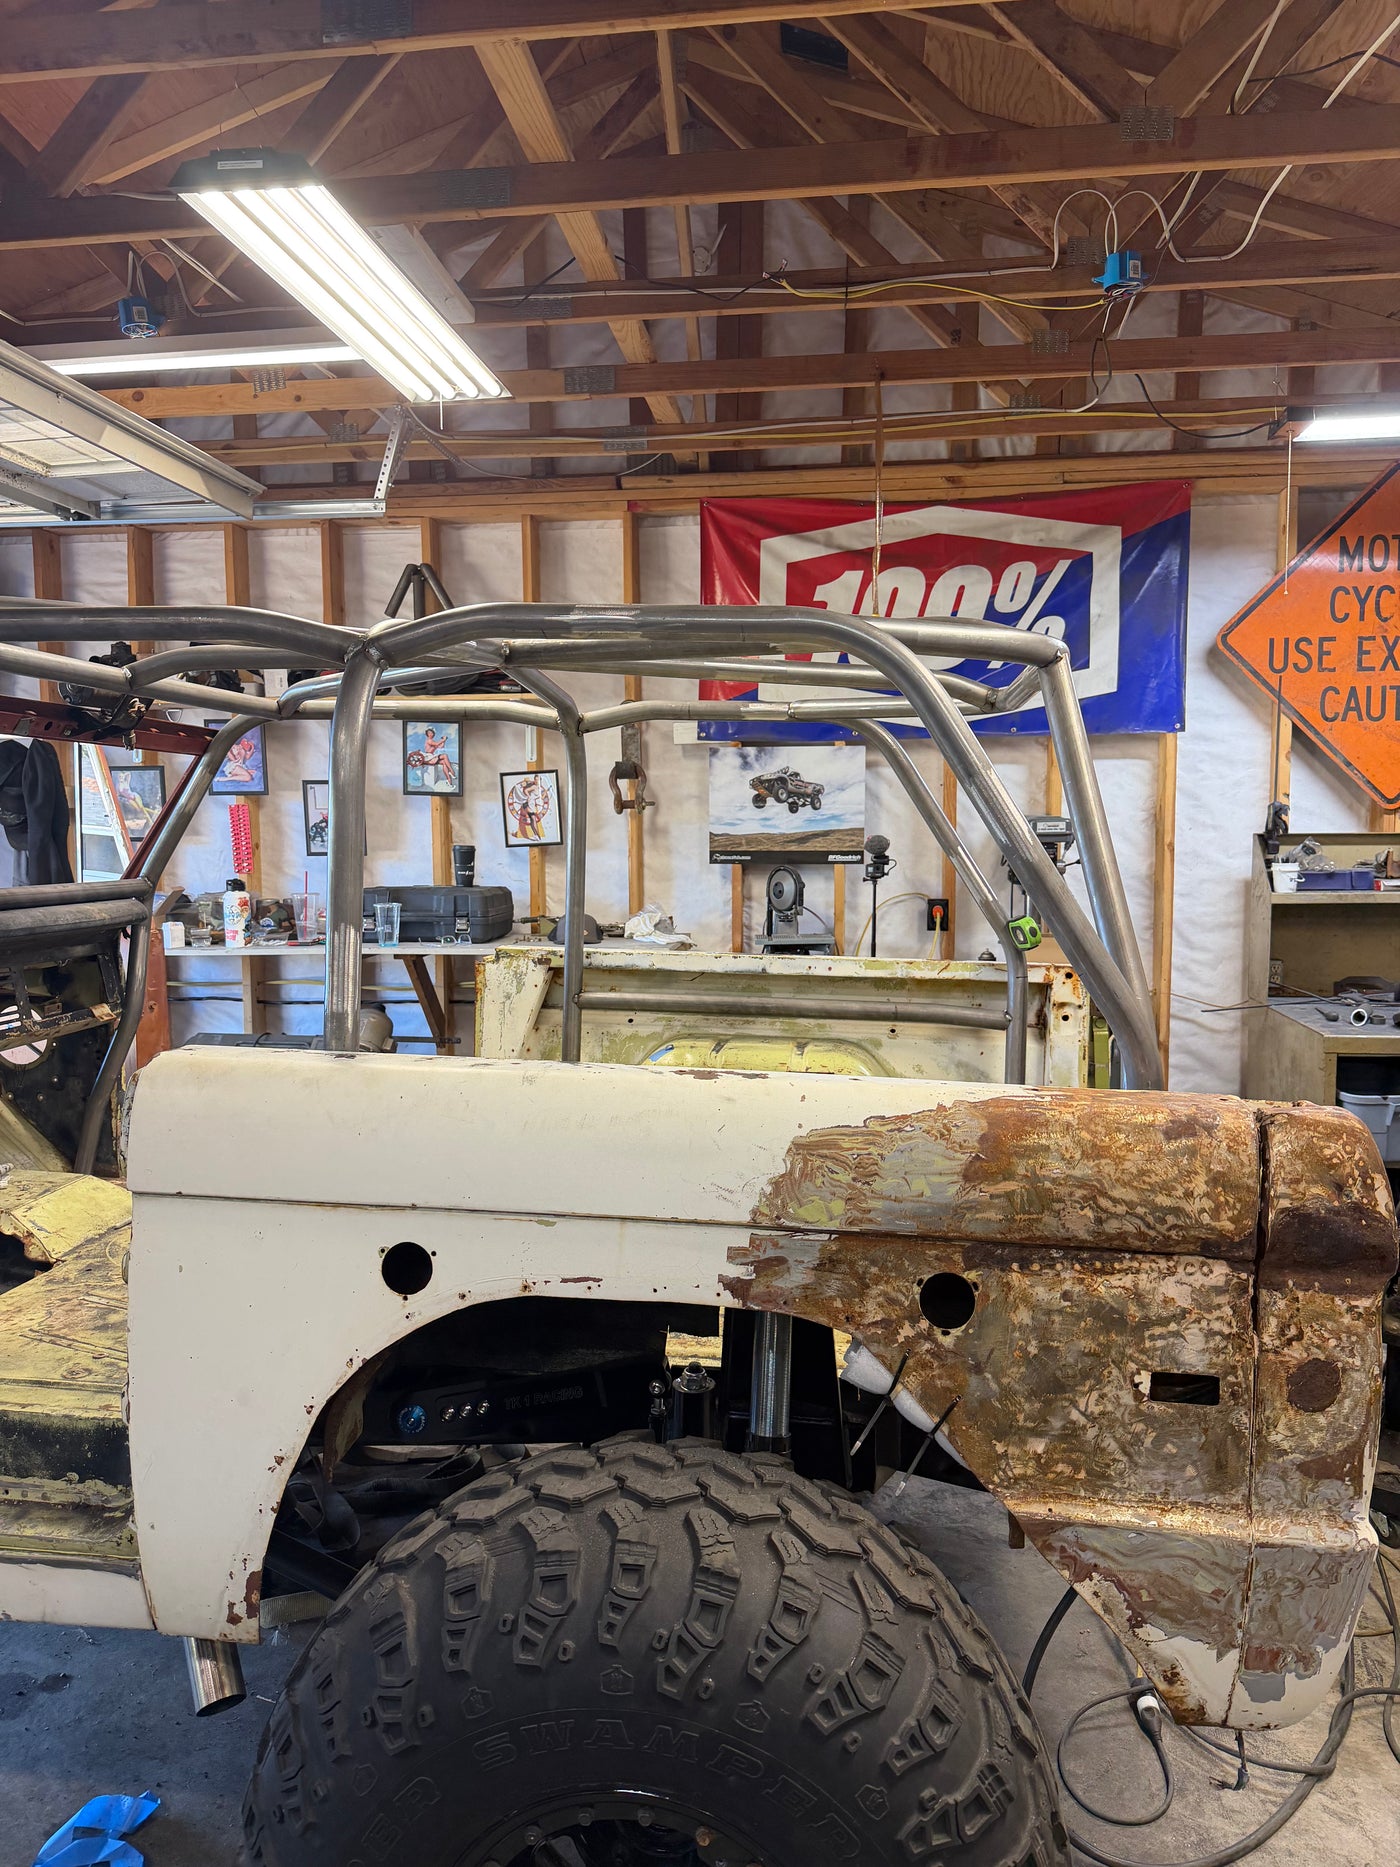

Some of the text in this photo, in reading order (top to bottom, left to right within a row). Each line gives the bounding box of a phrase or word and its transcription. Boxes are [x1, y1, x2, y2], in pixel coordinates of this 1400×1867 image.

[813, 560, 1073, 669] 100%
[1268, 636, 1400, 674] USE EX
[1320, 685, 1400, 723] CAUT
[472, 1719, 862, 1859] SWAMPER
